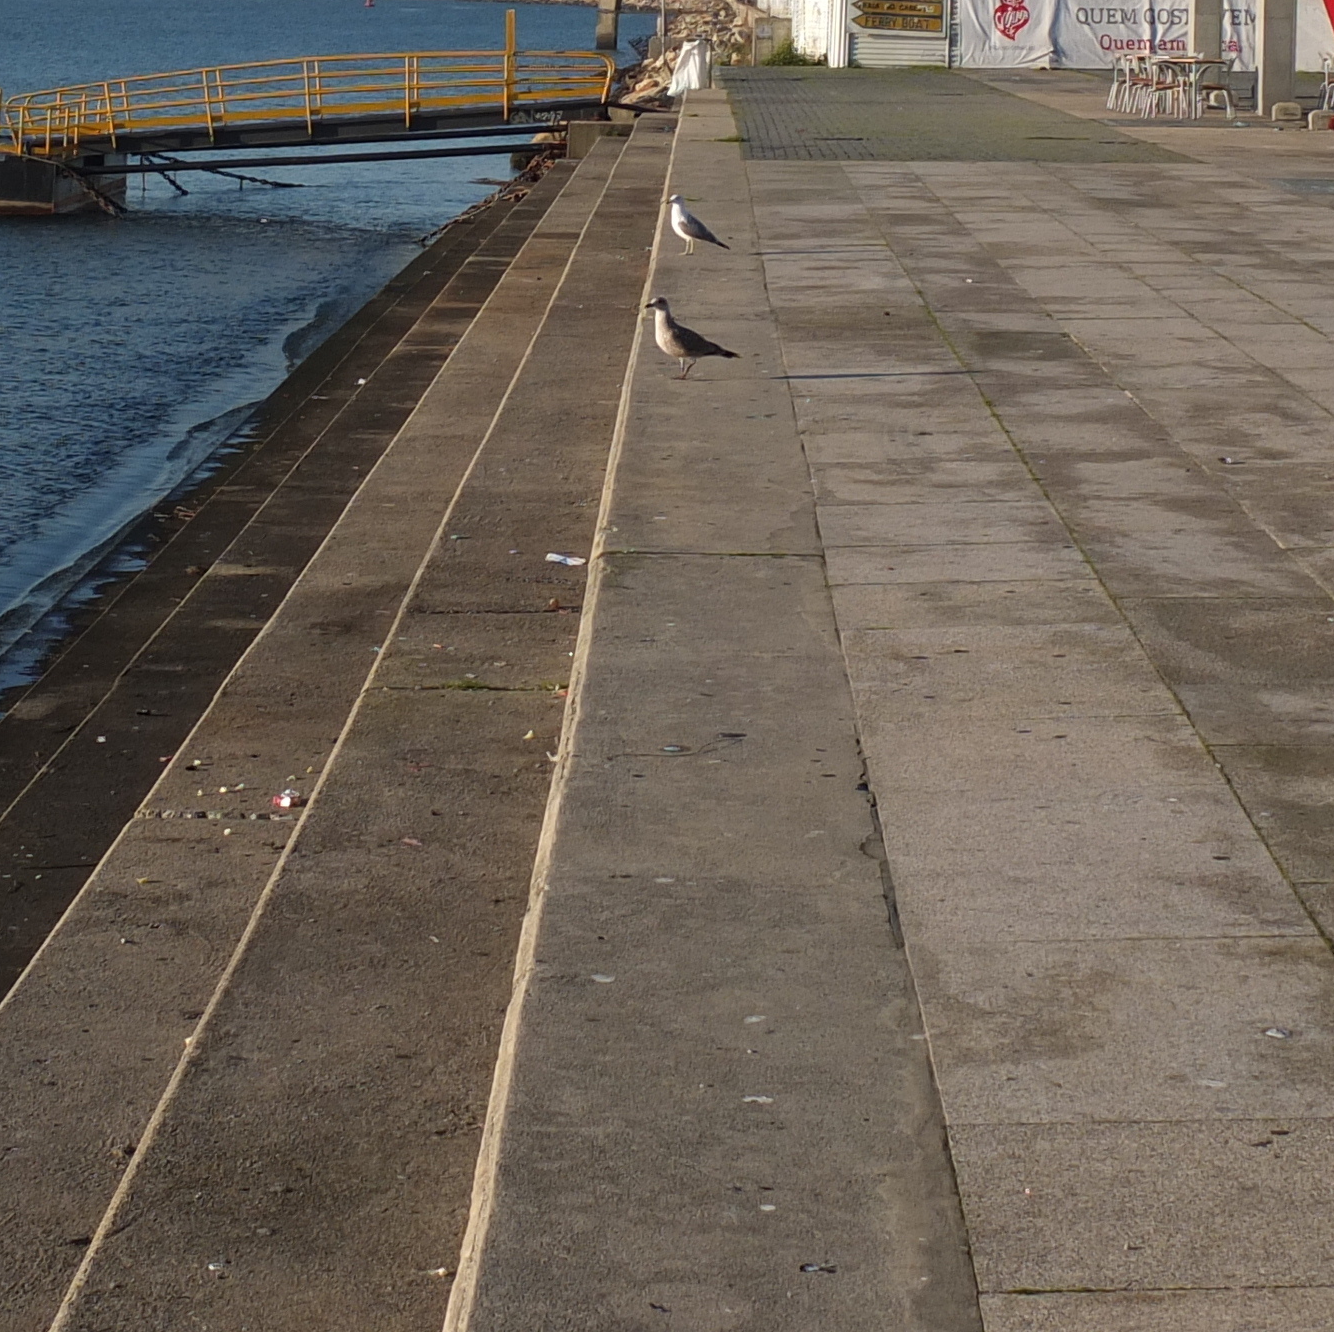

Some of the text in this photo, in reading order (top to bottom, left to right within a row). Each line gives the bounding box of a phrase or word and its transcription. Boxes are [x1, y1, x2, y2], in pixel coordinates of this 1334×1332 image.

[865, 16, 931, 29] FERRY BOAT
[1075, 7, 1138, 26] QUEM
[1099, 34, 1152, 52] Quem
